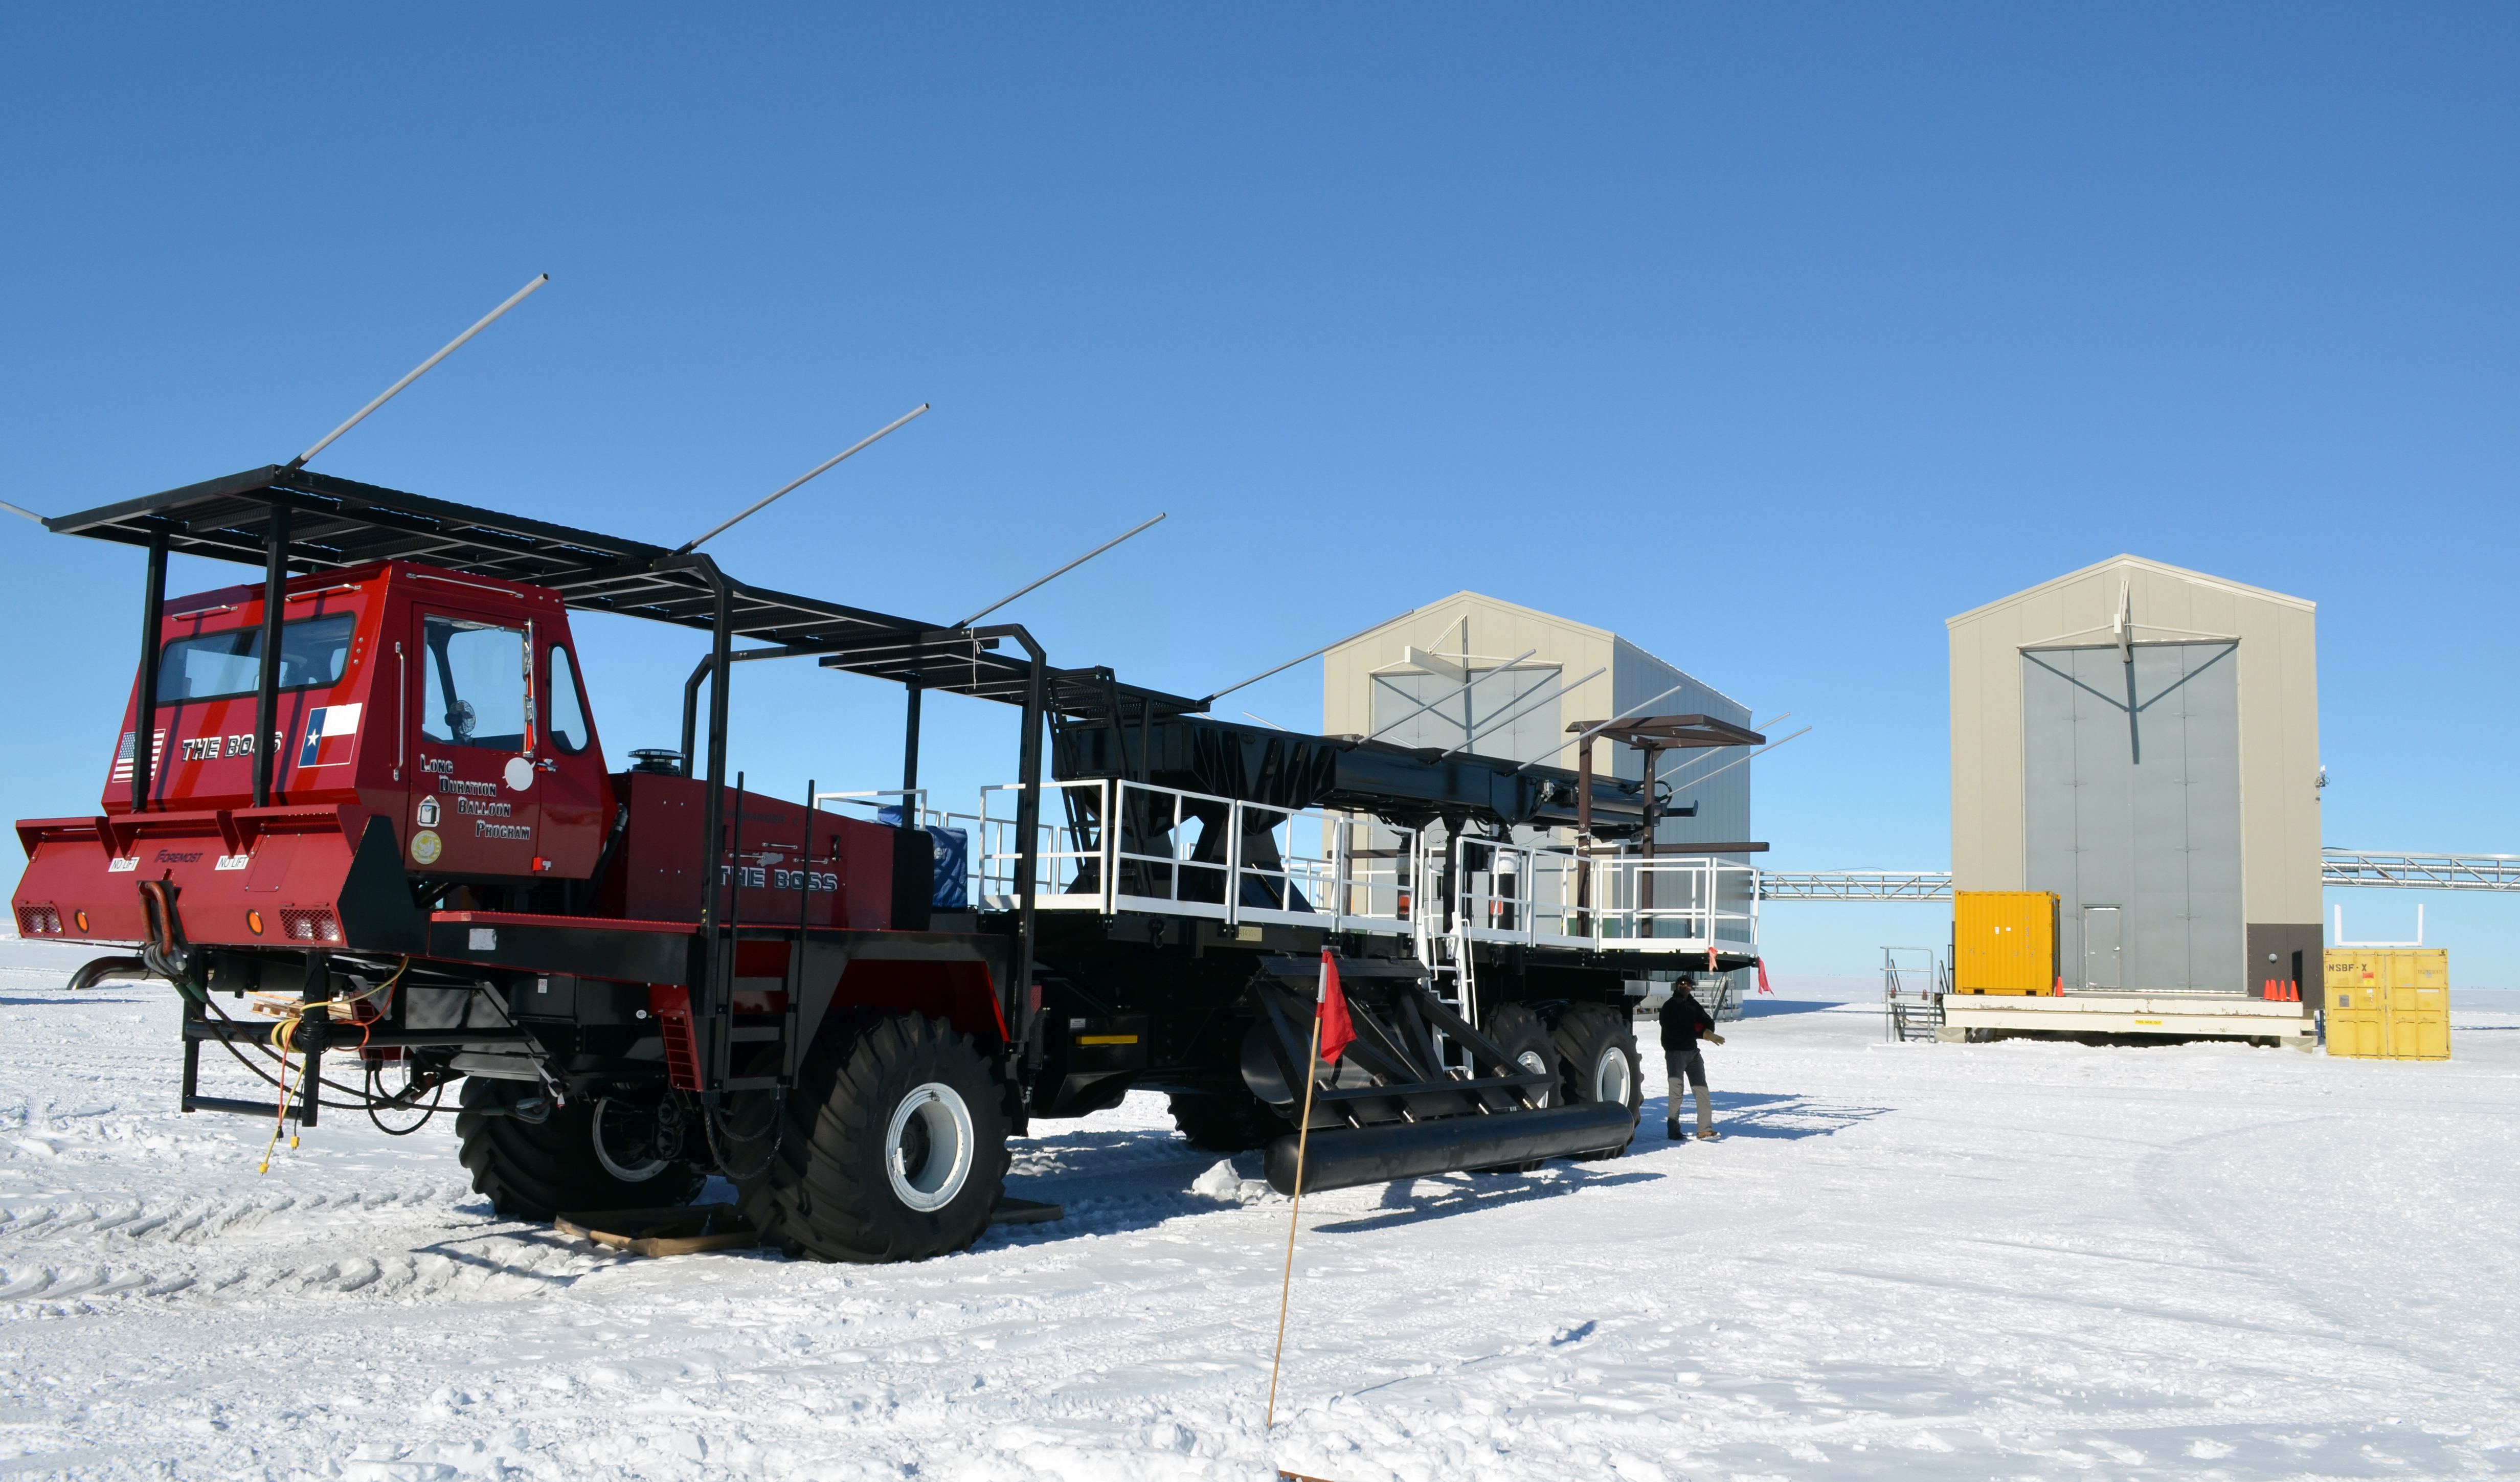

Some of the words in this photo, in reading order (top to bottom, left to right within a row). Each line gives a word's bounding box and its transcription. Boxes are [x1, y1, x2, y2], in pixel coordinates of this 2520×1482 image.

[182, 736, 222, 761] THE
[154, 849, 204, 863] FOREMOST
[218, 857, 230, 868] NO
[231, 857, 248, 867] LIFT
[112, 860, 123, 869] NO
[123, 859, 138, 869] LIFT
[721, 865, 766, 888] THE
[774, 869, 838, 892] BOSS
